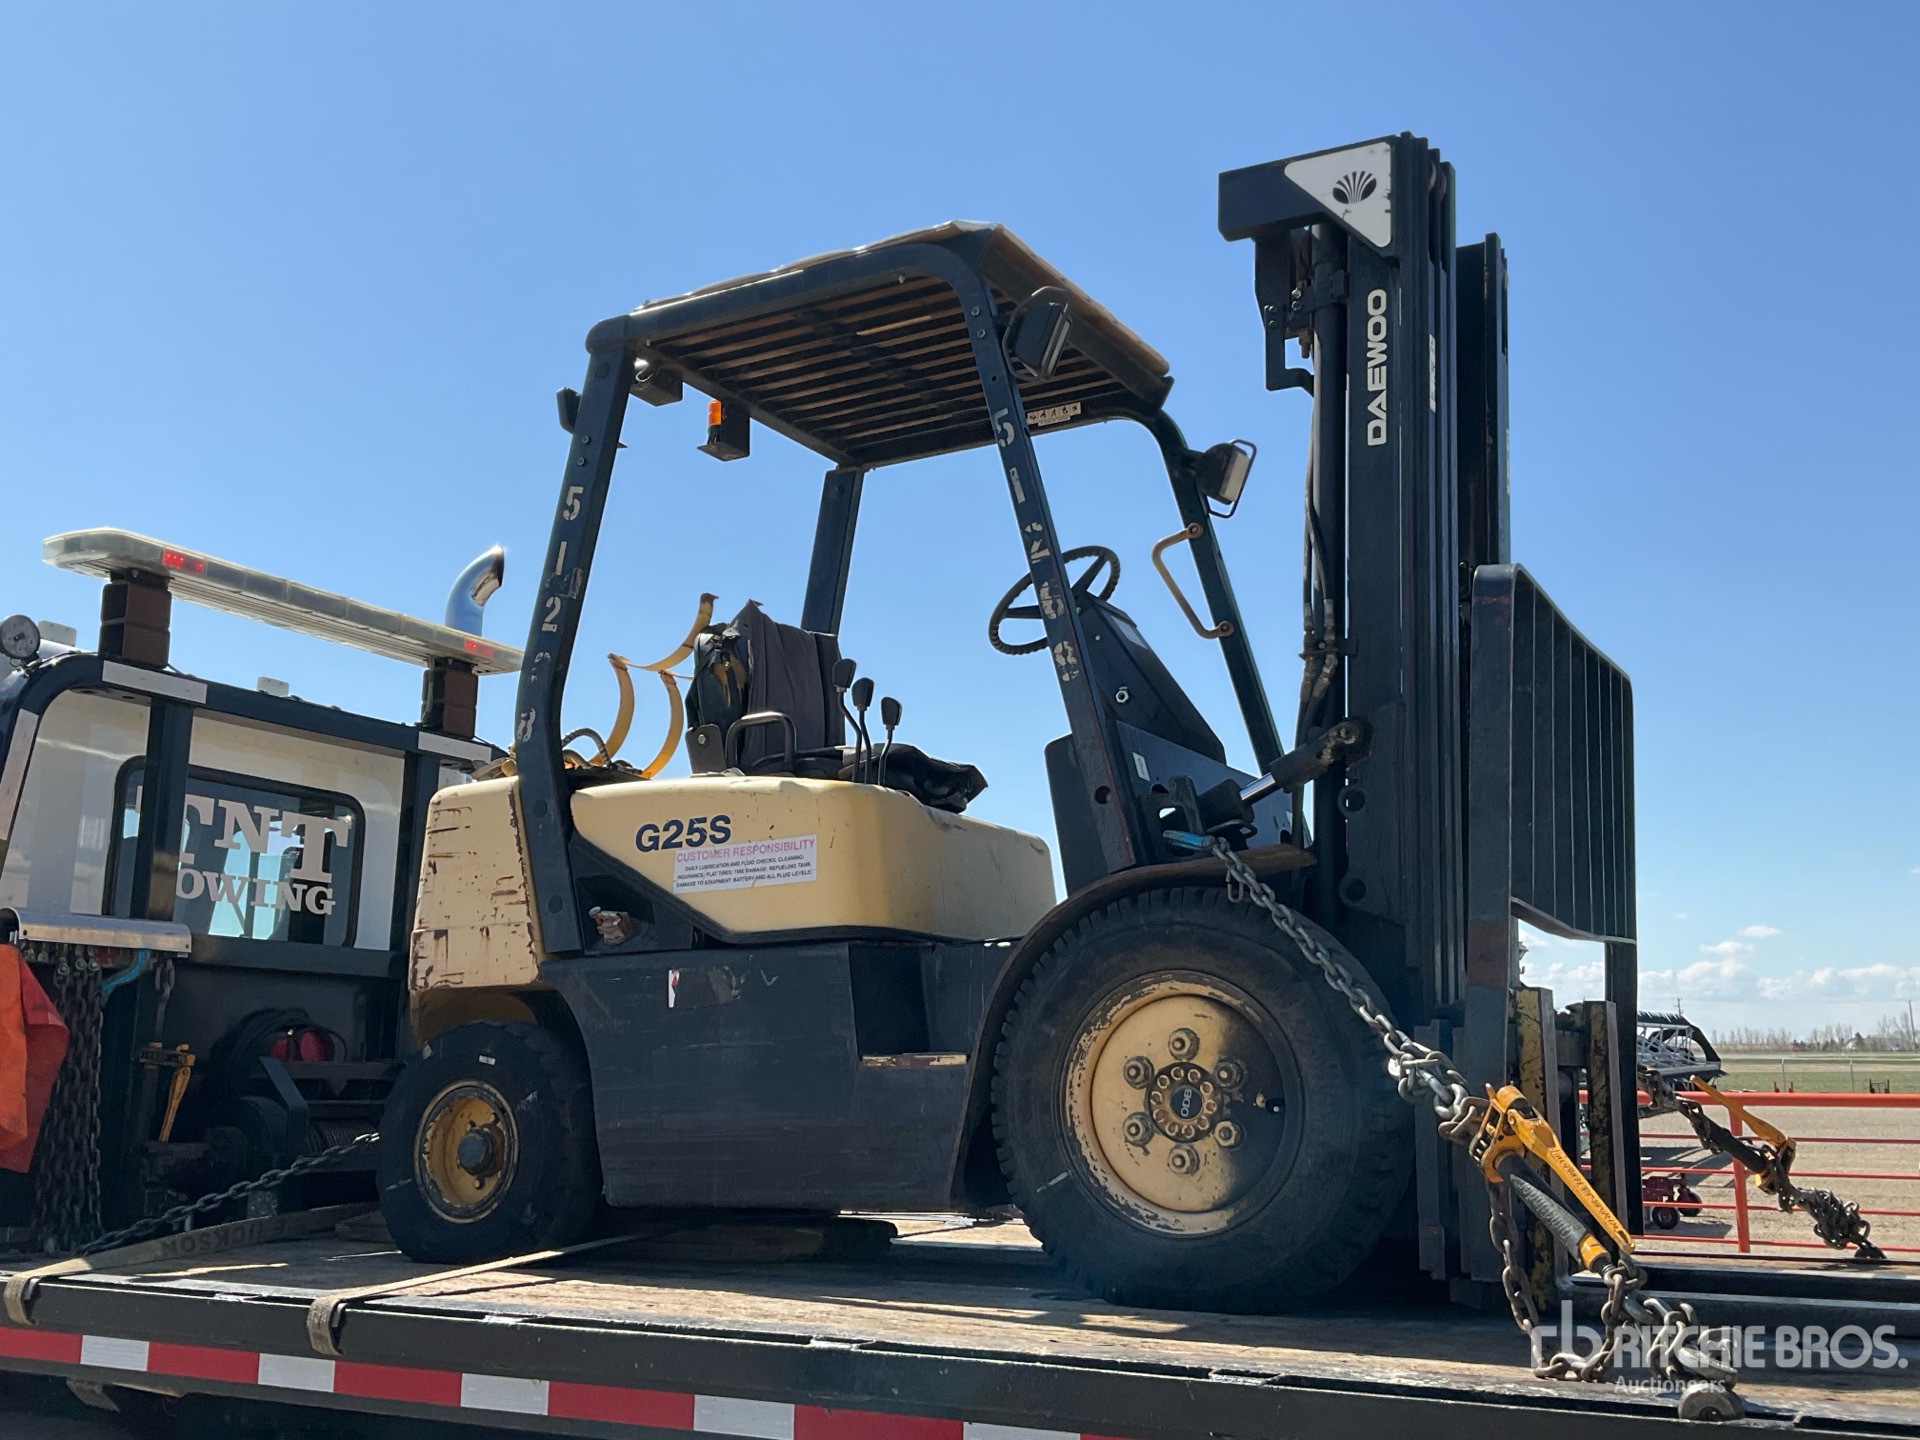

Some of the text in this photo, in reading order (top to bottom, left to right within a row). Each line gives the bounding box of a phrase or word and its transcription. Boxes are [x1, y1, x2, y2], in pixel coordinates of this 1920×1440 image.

[1366, 288, 1388, 446] DAEWOO
[635, 814, 732, 852] G25S
[676, 839, 815, 863] CUSTOMER RESPONSIBILITY
[699, 862, 729, 871] LUBRICATION
[769, 863, 797, 871] REFUELING
[175, 867, 336, 915] OWING
[733, 875, 755, 883] BATTERY
